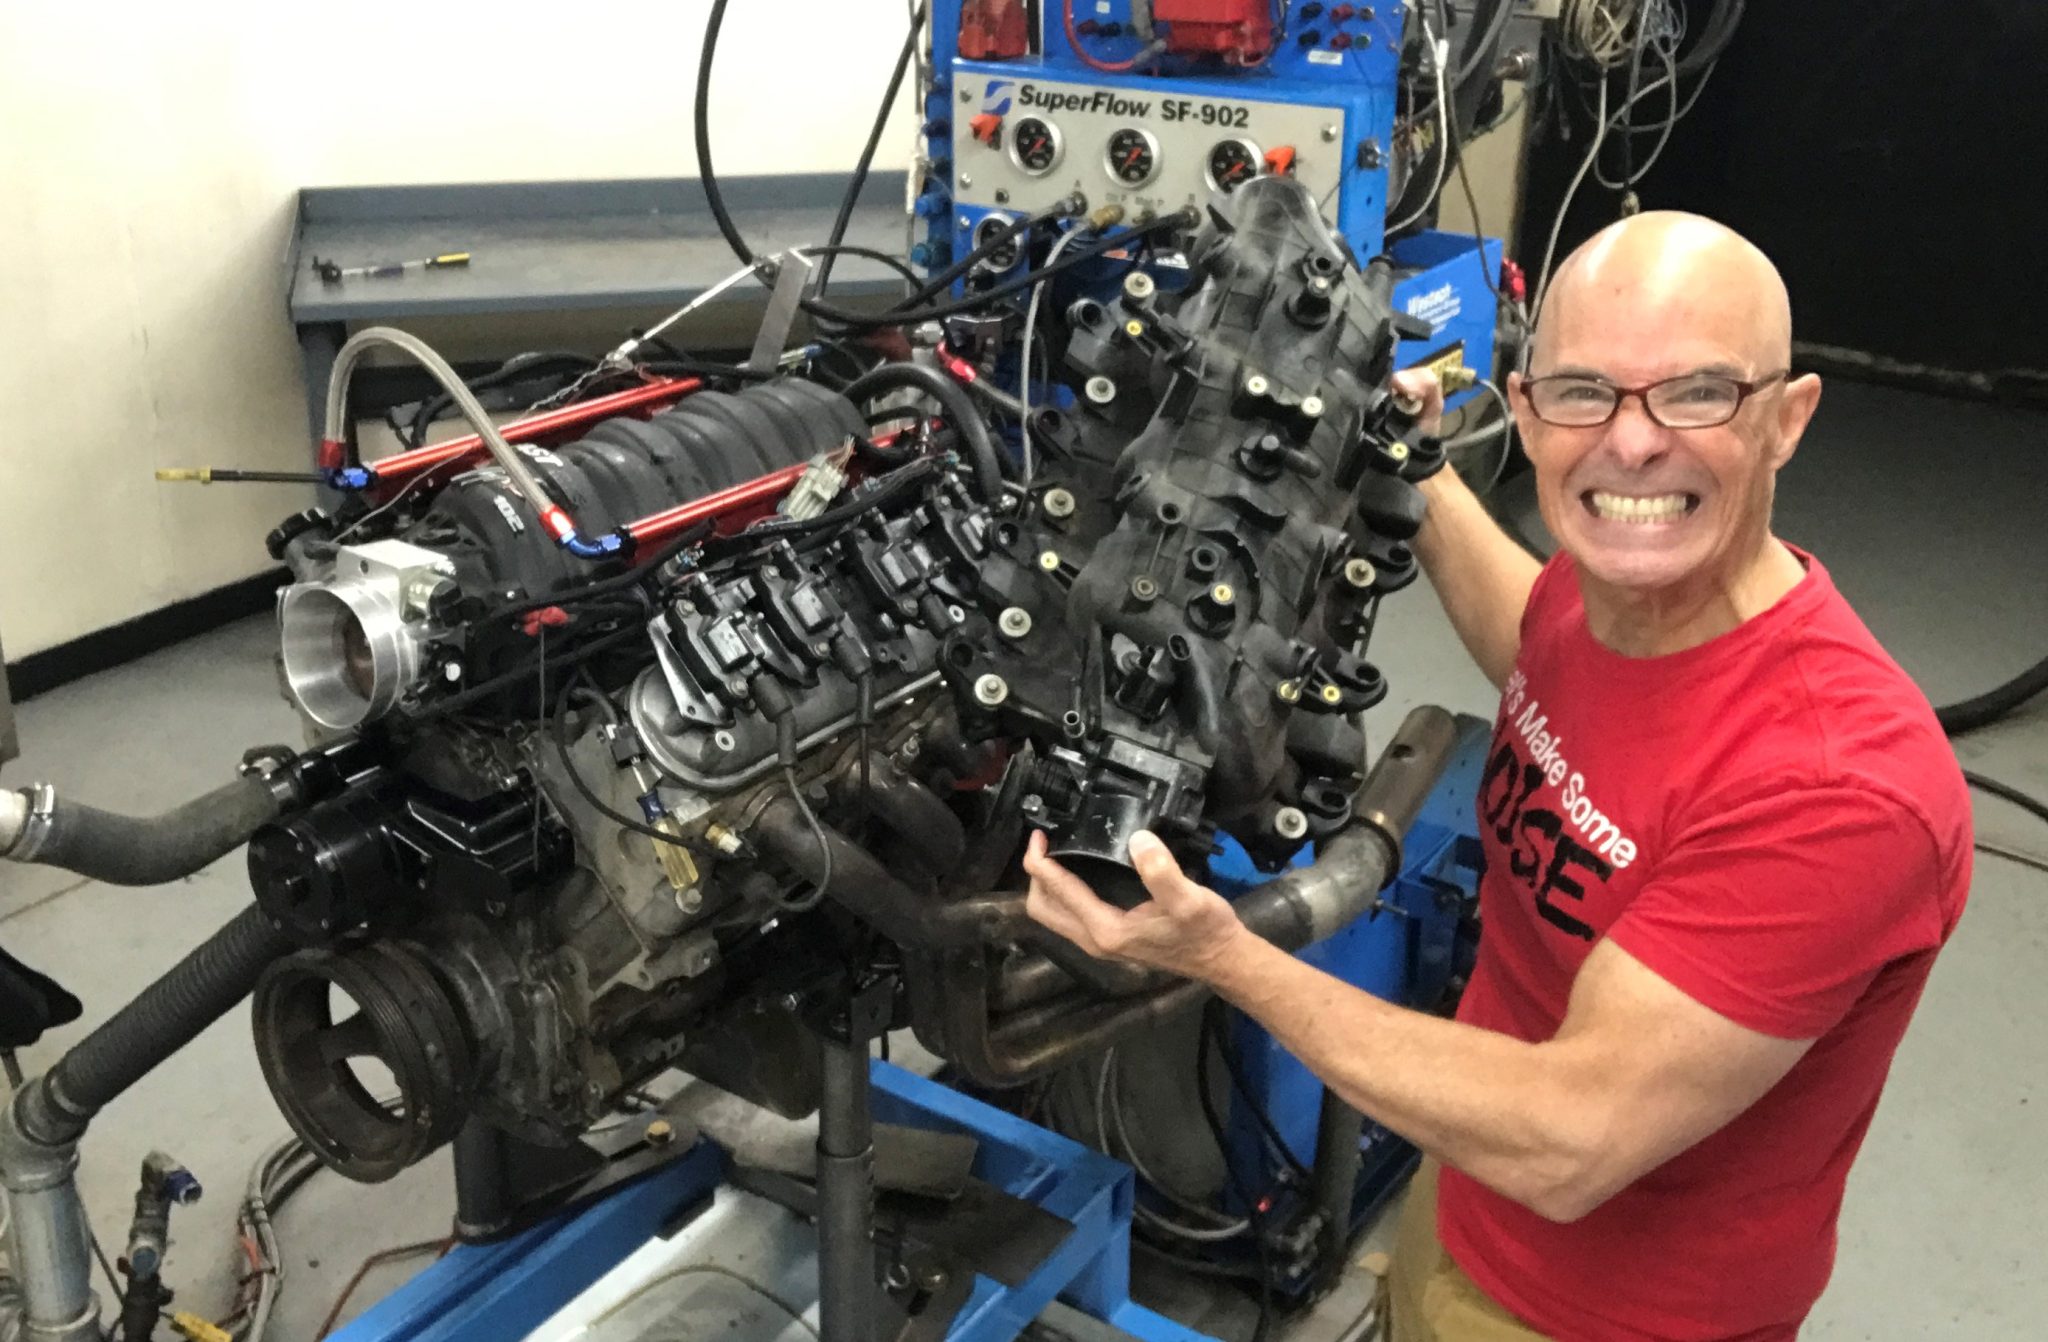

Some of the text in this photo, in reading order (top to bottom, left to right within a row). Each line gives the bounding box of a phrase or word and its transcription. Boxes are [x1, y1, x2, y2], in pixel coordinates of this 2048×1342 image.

[1018, 84, 1249, 128] SuperFlow SF-902
[493, 495, 525, 532] 102
[1478, 717, 1614, 941] OISE
[1515, 700, 1568, 787] Make
[1561, 773, 1638, 869] Some
